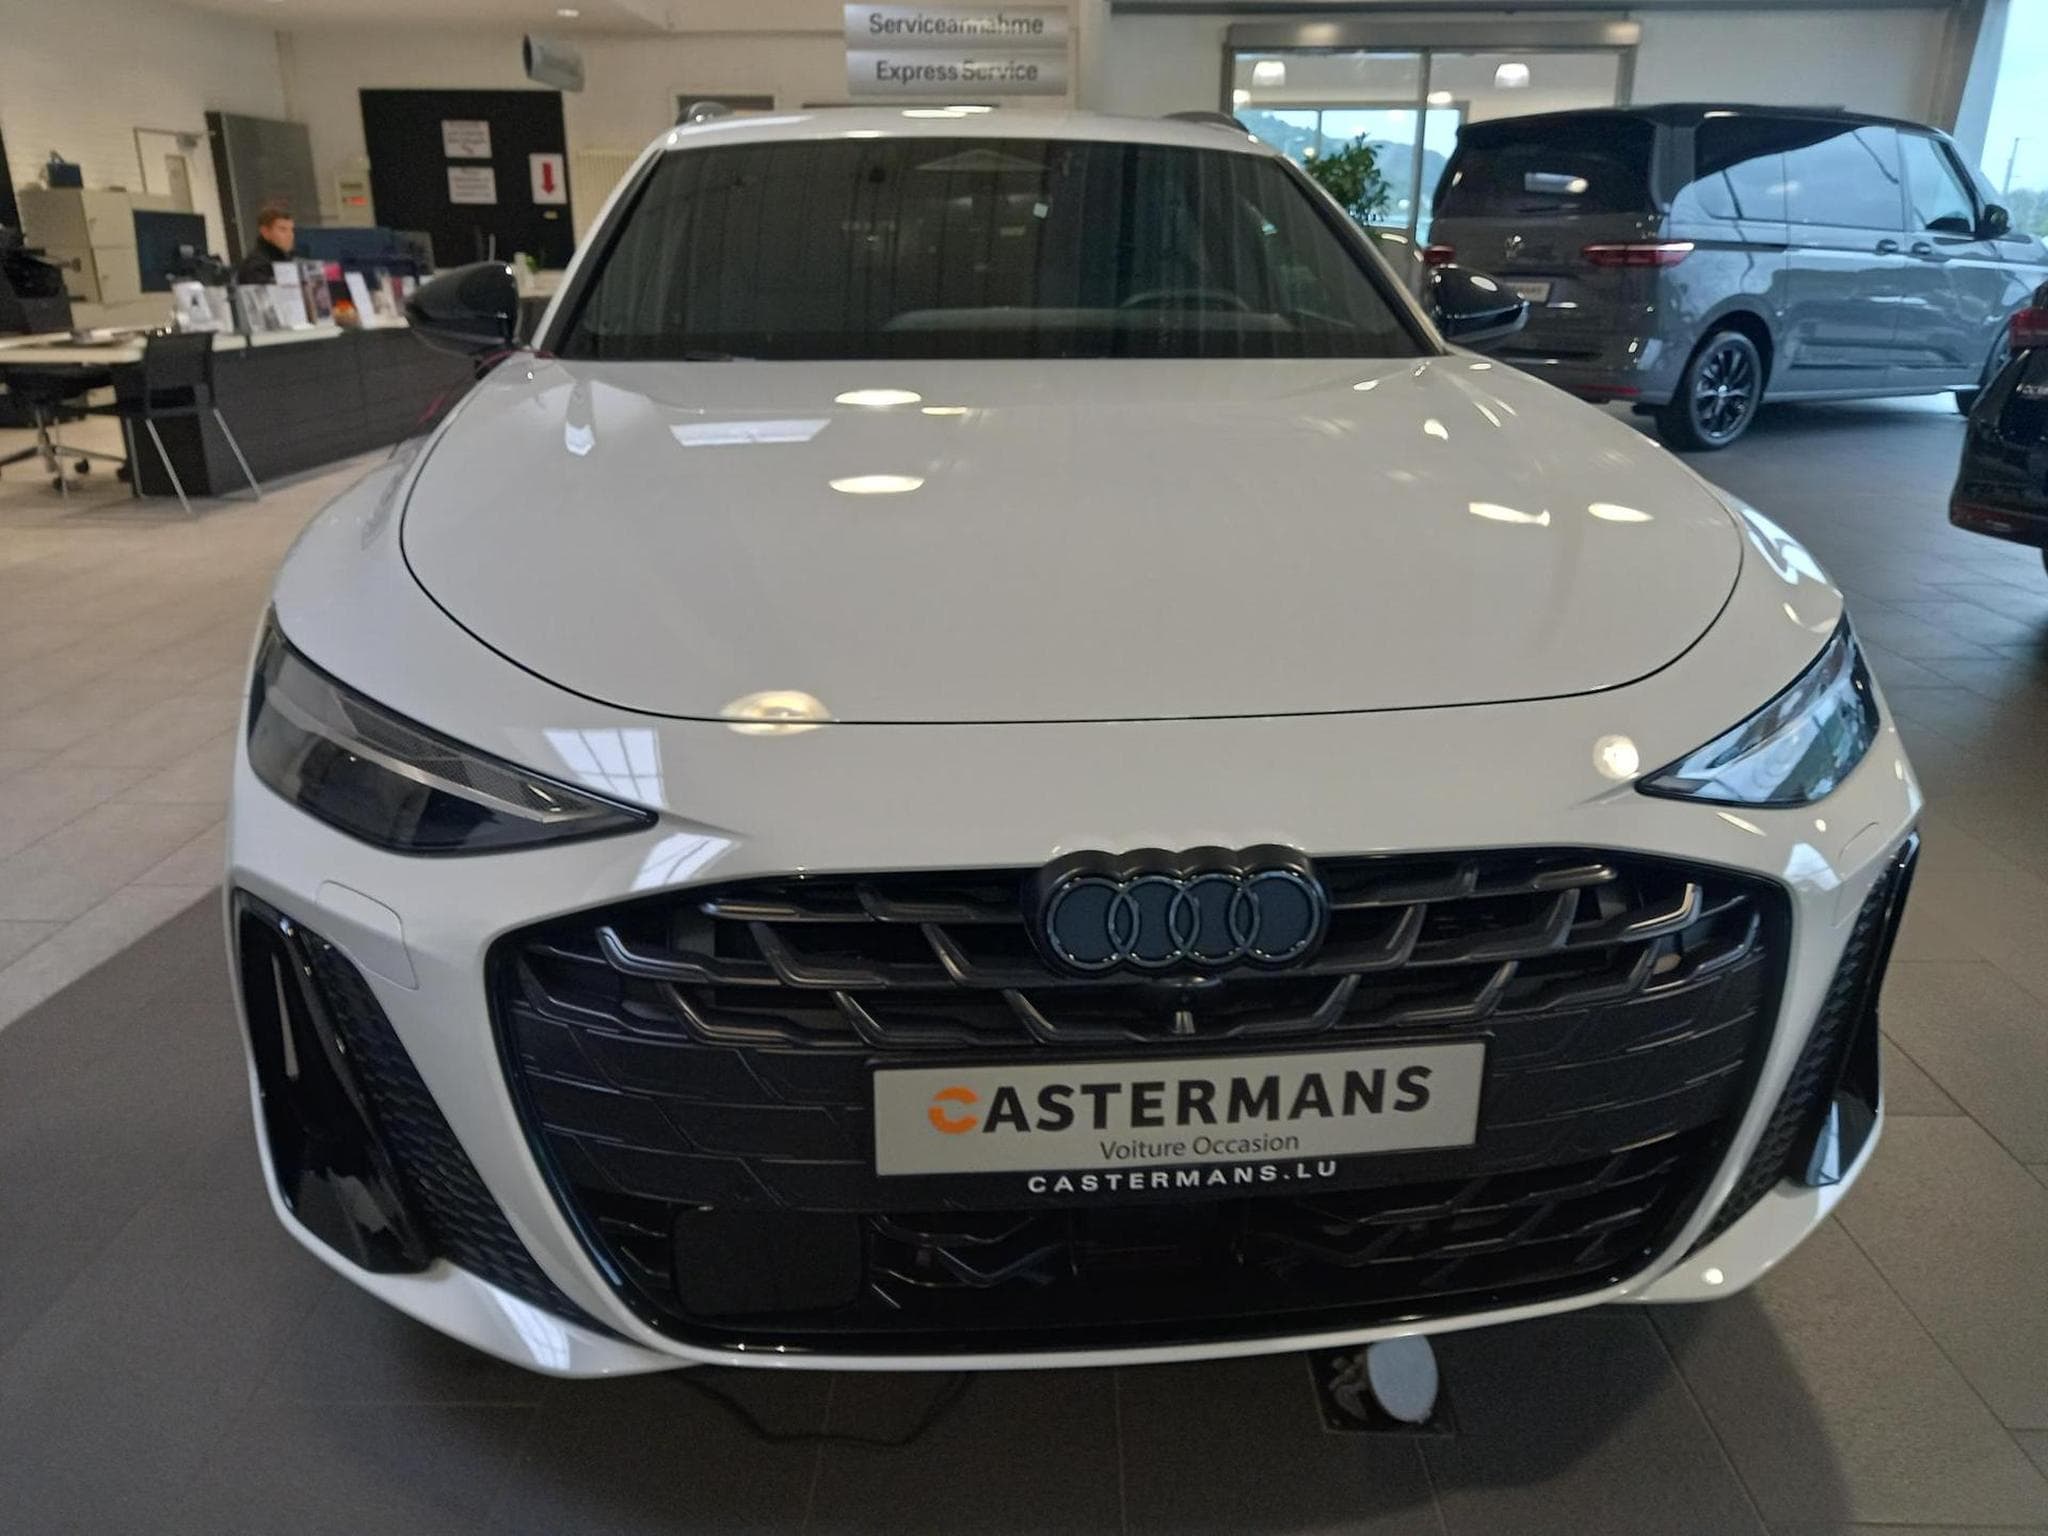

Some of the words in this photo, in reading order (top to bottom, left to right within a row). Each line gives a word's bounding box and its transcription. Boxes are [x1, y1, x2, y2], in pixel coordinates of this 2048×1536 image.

[869, 12, 1044, 35] Serviceannahme
[876, 60, 959, 85] Express
[961, 60, 1039, 81] Service
[927, 1065, 1433, 1136] CASTERMANS
[1100, 1139, 1187, 1161] Voiture
[1192, 1133, 1300, 1156] Occasion
[1027, 1160, 1337, 1194] CASTERMANS.LU
